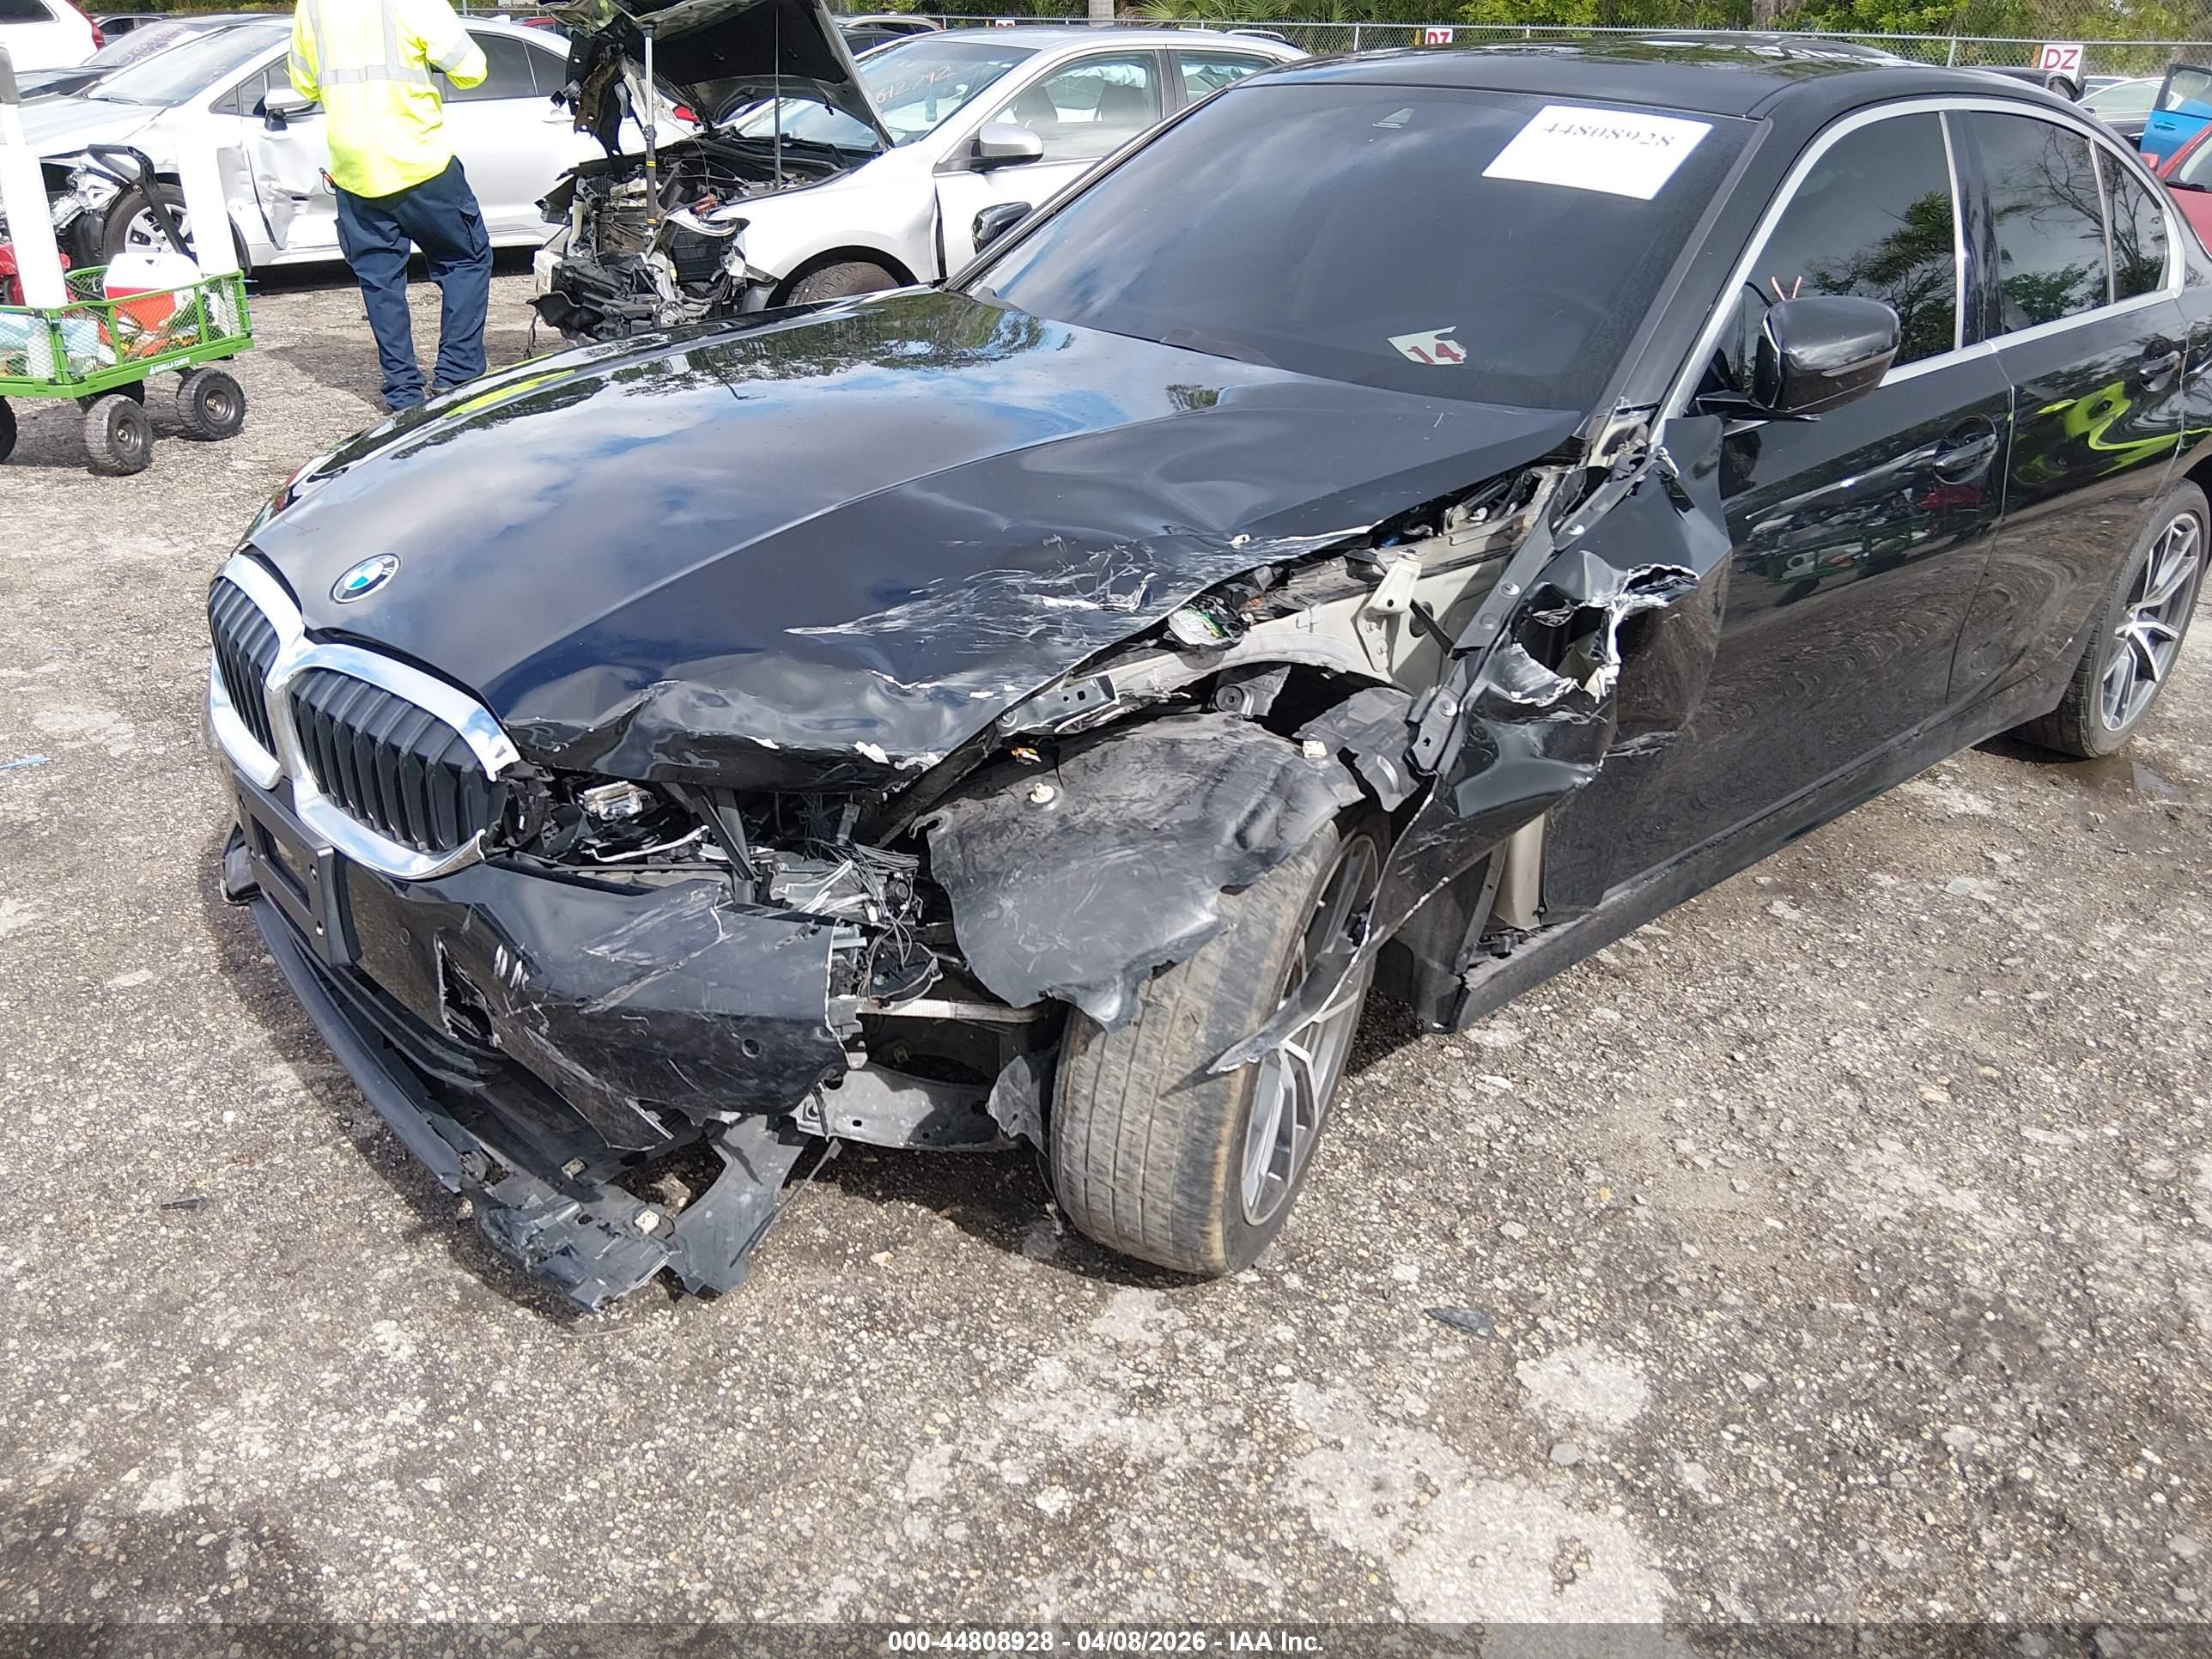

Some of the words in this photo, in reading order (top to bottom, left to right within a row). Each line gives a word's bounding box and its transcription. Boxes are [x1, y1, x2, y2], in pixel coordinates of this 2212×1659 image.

[2043, 48, 2079, 70] DZ
[1543, 122, 1675, 147] 44808928
[1406, 343, 1463, 364] 14
